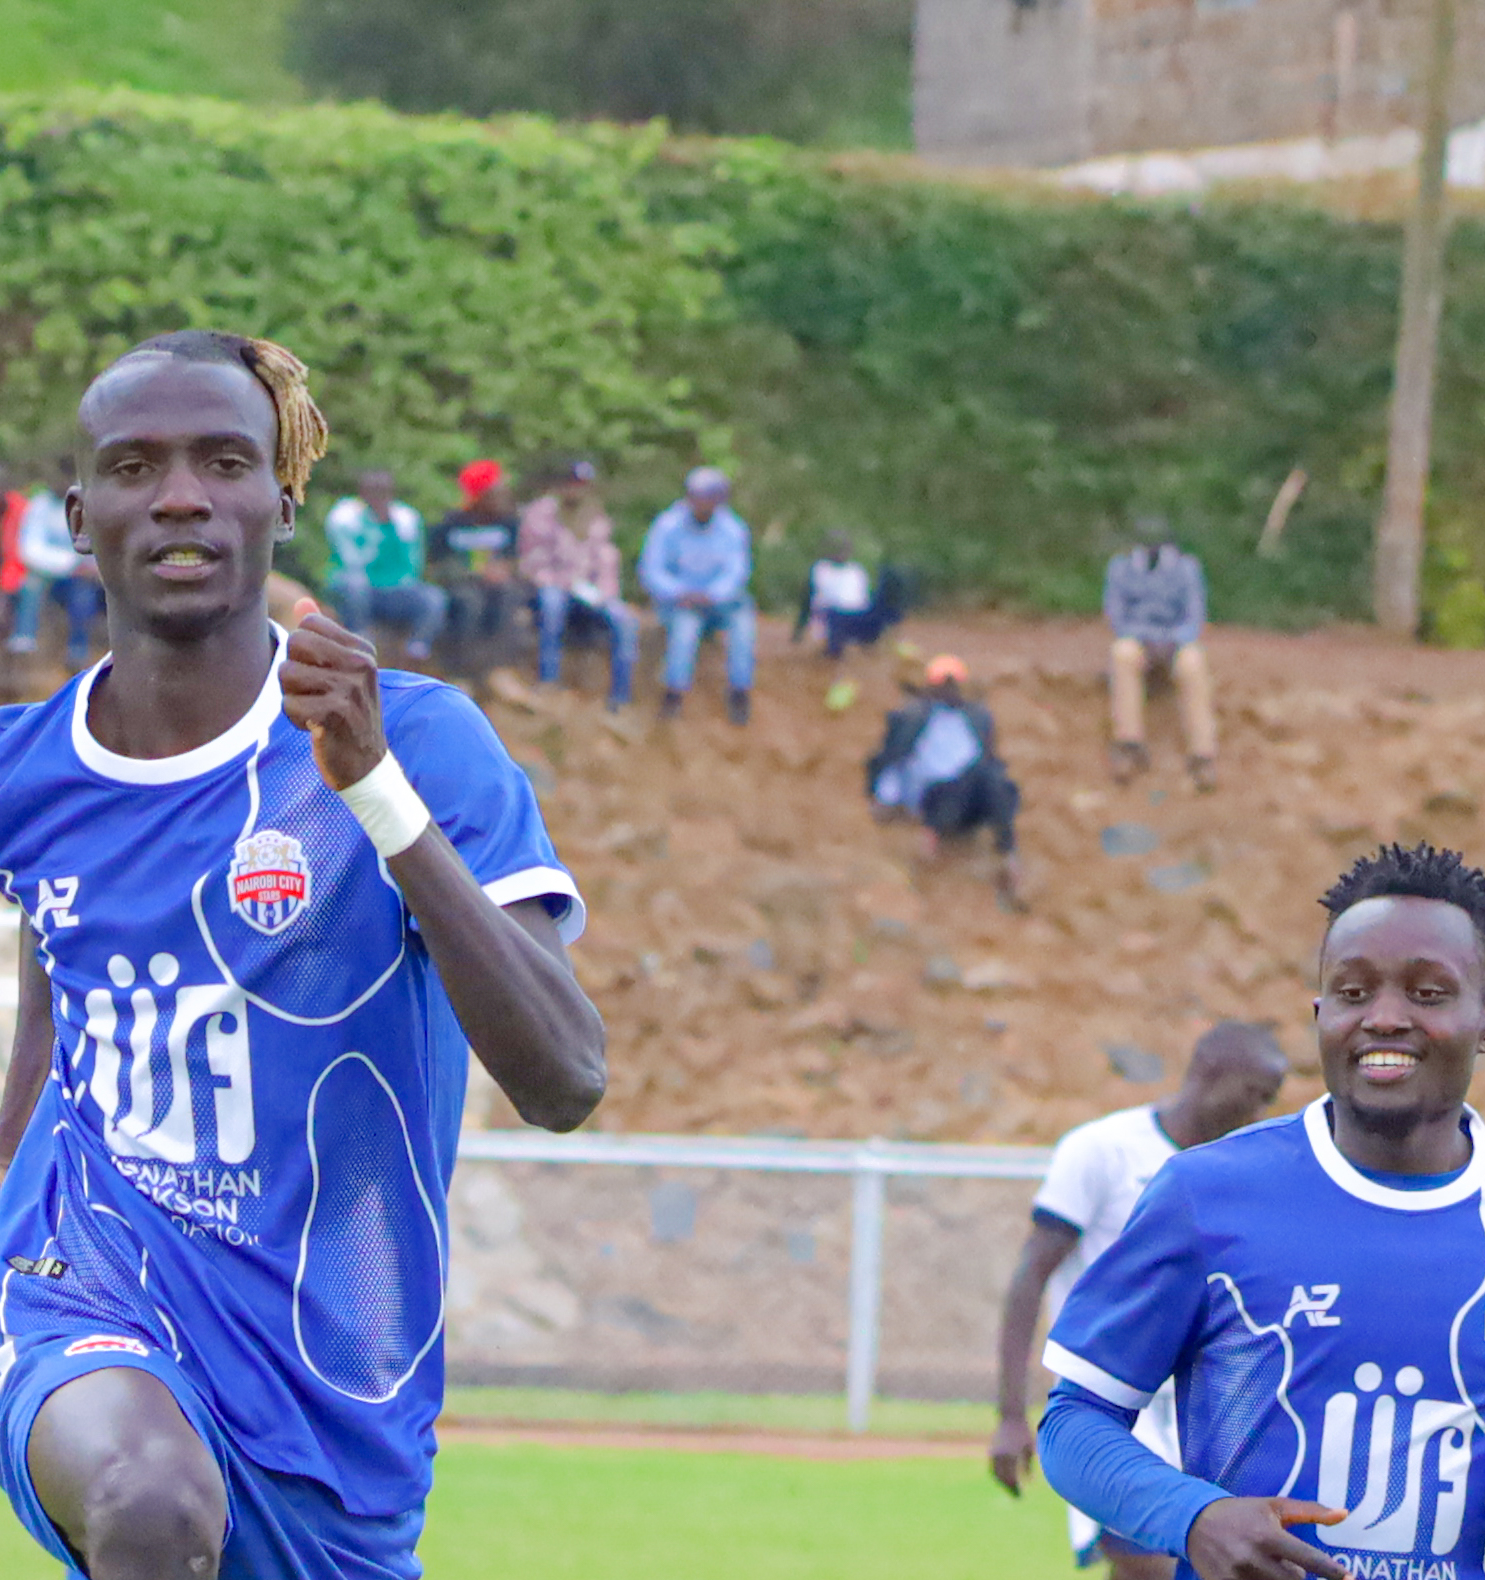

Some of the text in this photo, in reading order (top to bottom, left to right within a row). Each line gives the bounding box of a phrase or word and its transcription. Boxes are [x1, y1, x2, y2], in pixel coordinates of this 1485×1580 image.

[236, 874, 303, 895] NAIROBI CITY
[1283, 1285, 1341, 1328] AZ
